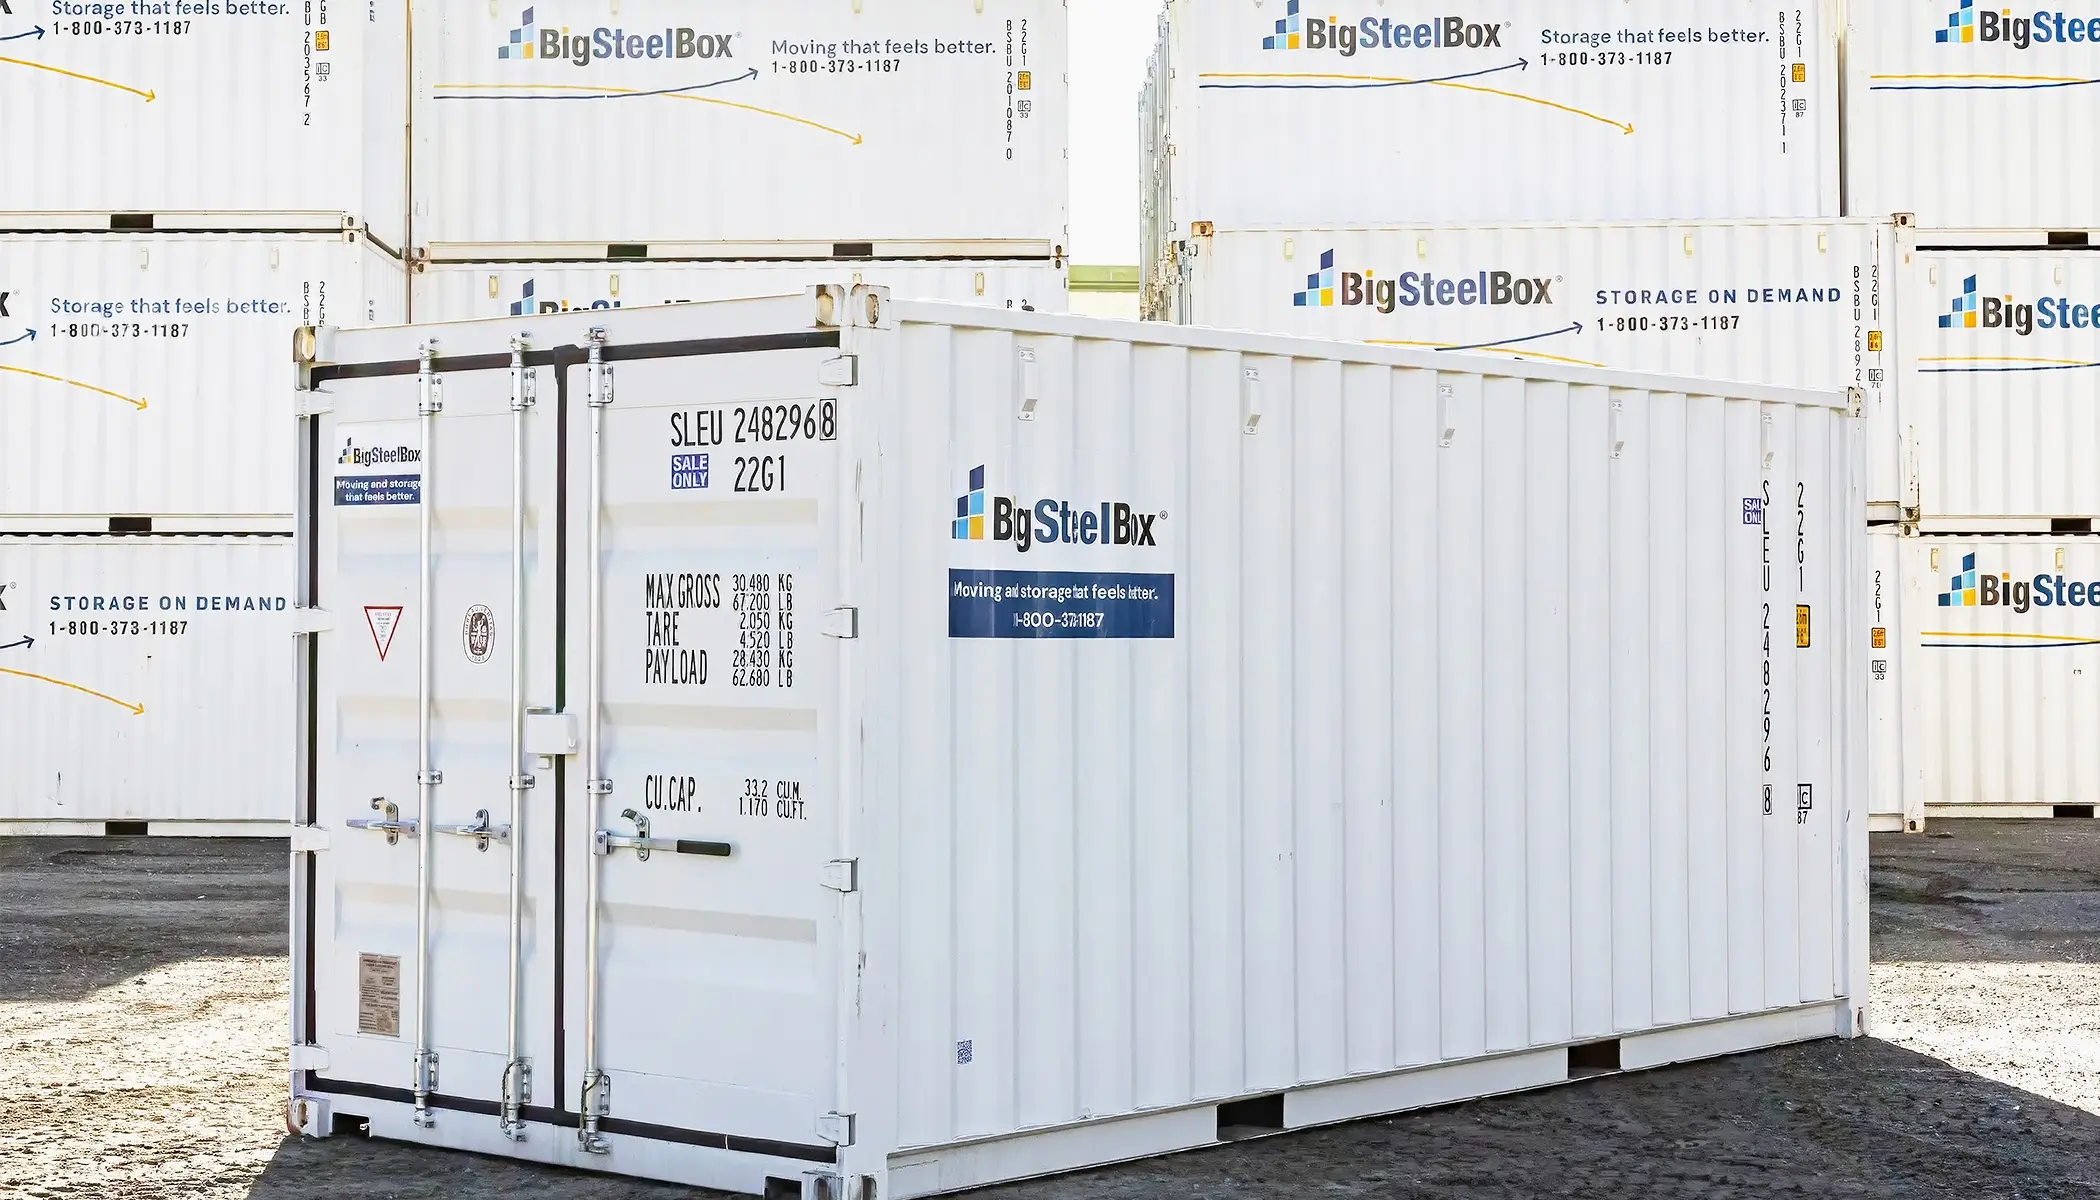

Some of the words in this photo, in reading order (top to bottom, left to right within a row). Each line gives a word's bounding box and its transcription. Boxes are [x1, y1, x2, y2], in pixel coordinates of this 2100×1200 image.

[52, 0, 124, 20] Storage
[130, 0, 170, 15] that
[175, 0, 219, 15] feels
[226, 0, 289, 15] better.
[54, 21, 190, 35] 1-800-373-1187
[1307, 16, 1501, 57] BigSteelBox
[540, 27, 732, 66] BigSteelBox
[1542, 29, 1611, 48] Storage
[1617, 29, 1653, 43] that
[1658, 28, 1702, 42] feels
[1709, 27, 1769, 42] better.
[773, 40, 836, 58] Moving
[842, 40, 880, 54] that
[885, 39, 928, 54] feels
[935, 39, 995, 53] better.
[773, 59, 900, 73] 1-800-373-1187
[1541, 52, 1672, 65] 1-800-373-1187
[1342, 270, 1553, 314] BigSteelBox
[1597, 290, 1697, 304] STORAGE
[1709, 289, 1736, 303] ON
[1748, 288, 1840, 302] DEMAND
[51, 298, 123, 318] Storage
[131, 298, 170, 313] that
[175, 298, 219, 313] feels
[227, 297, 291, 314] better.
[51, 324, 188, 337] 1-800-373-1187
[1598, 316, 1739, 331] 1-800-373-1187
[671, 410, 722, 447] SLEU
[354, 446, 421, 467] BigSteelBox
[673, 456, 707, 471] SALE
[673, 473, 707, 488] ONLY
[734, 455, 784, 492] 22G1
[337, 481, 369, 490] Moving
[371, 479, 388, 488] and
[346, 493, 363, 501] that
[365, 492, 384, 501] feels
[387, 492, 415, 501] better.
[994, 496, 1156, 552] BigSteelBox
[646, 573, 673, 609] MAX
[678, 573, 720, 608] GROSS
[779, 574, 792, 592] KG
[1021, 585, 1071, 602] storage
[1092, 584, 1125, 599] feels
[50, 596, 148, 610] STORAGE
[160, 596, 185, 610] ON
[197, 596, 286, 611] DEMAND
[779, 593, 792, 611] LB
[50, 621, 187, 635] 1-800-373-1187
[646, 611, 679, 646] TARE
[779, 612, 793, 631] KG
[779, 631, 794, 649] LB
[646, 649, 707, 684] PAYLOAD
[779, 650, 792, 668] KG
[779, 669, 792, 687] LB
[1762, 603, 1770, 772] 248296
[745, 779, 767, 798] 33.2
